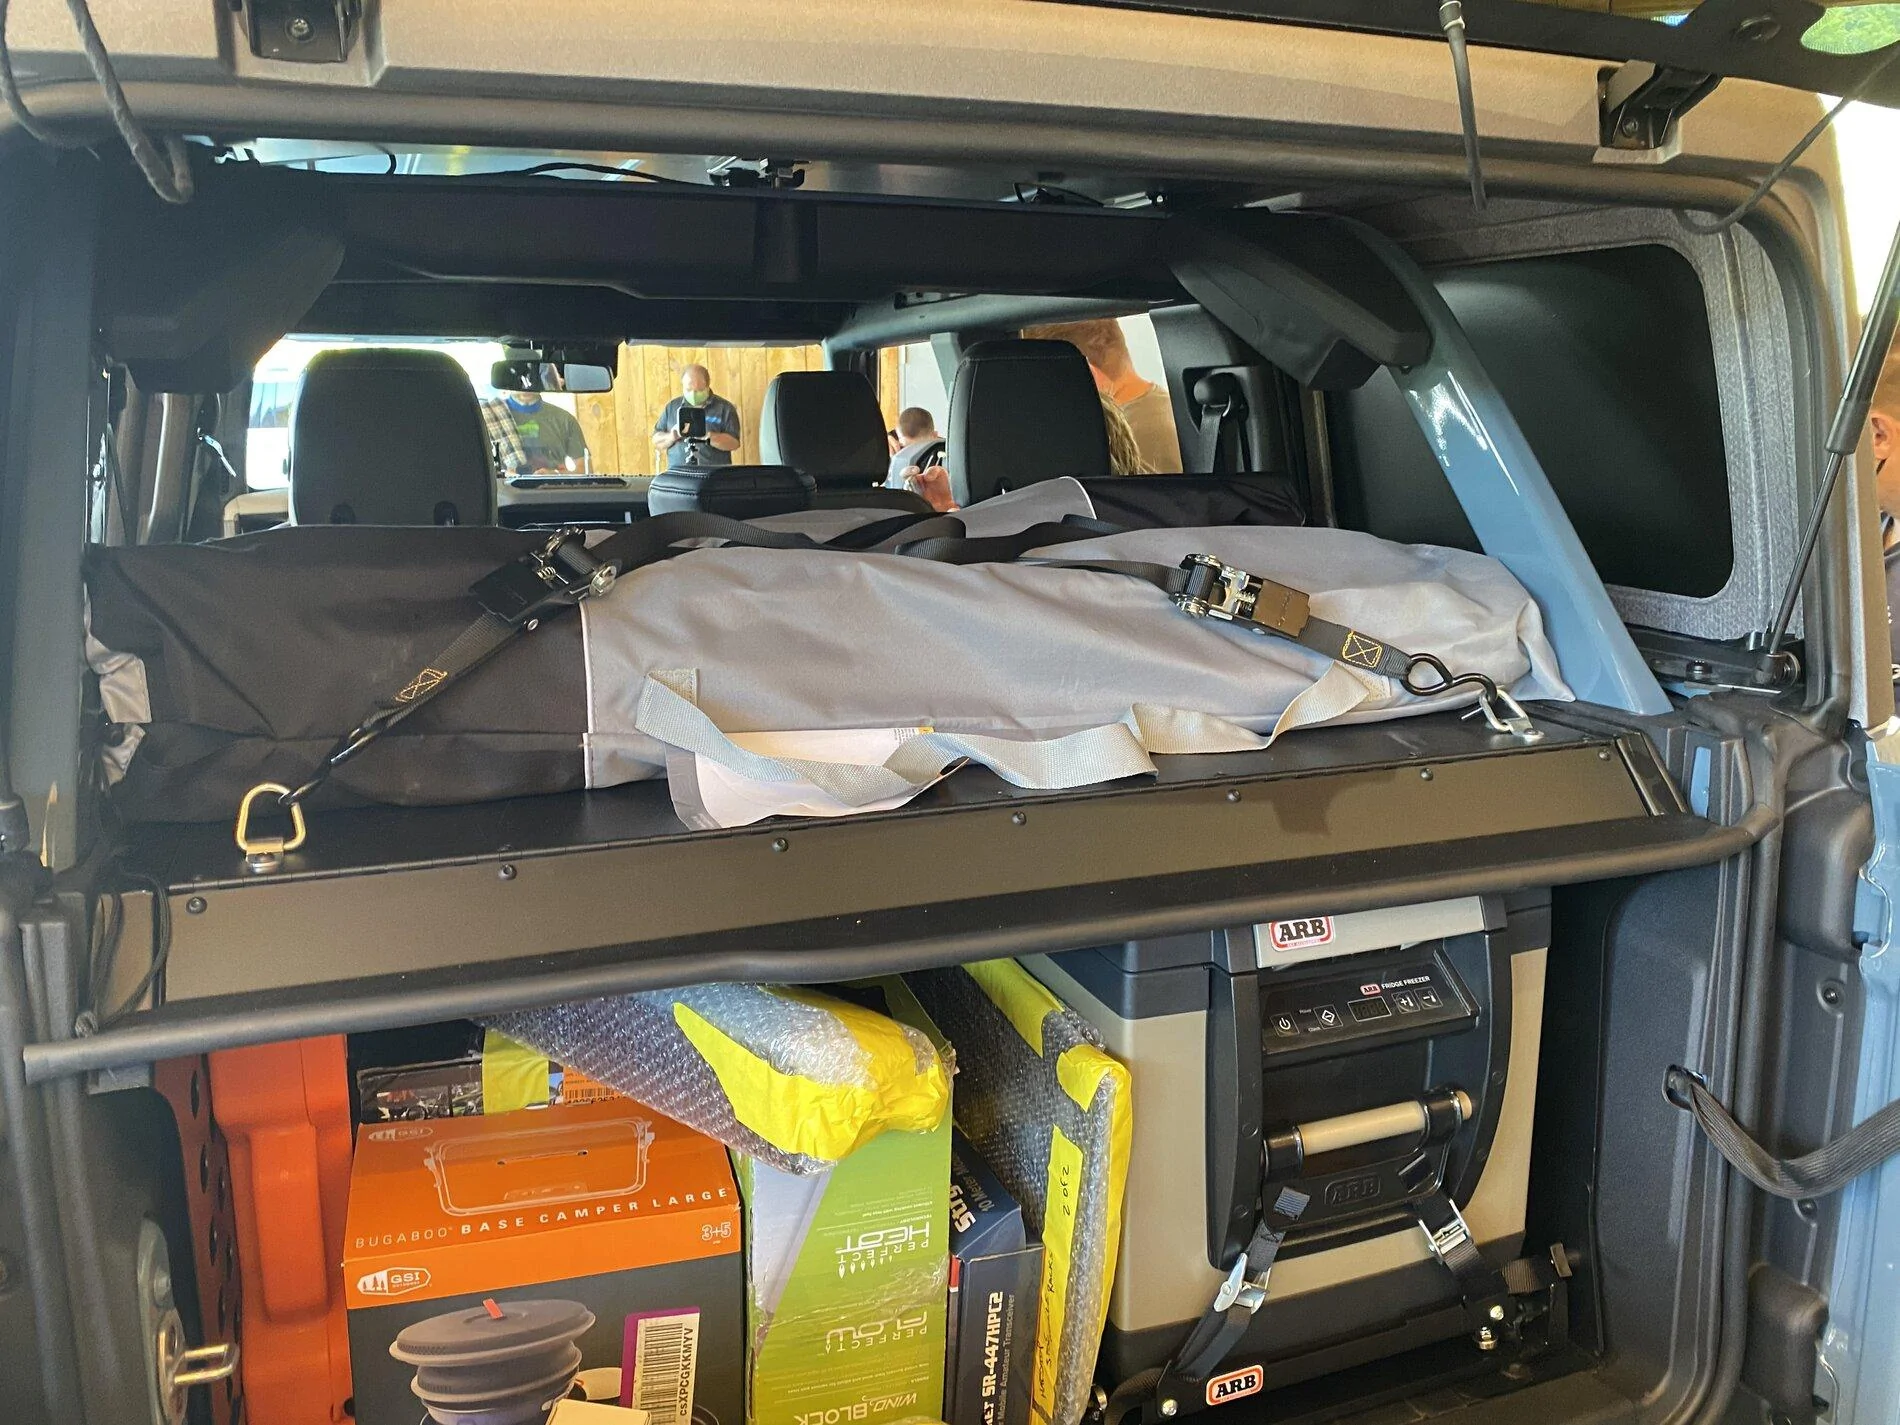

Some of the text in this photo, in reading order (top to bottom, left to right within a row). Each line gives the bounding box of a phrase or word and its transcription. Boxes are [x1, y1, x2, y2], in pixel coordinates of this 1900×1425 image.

[1280, 919, 1326, 942] ARB
[1363, 976, 1431, 993] ARB FRIDGE FREEZER
[1062, 1164, 1070, 1176] 2
[355, 1188, 729, 1249] BUGABOO BASE CAMPER LARGE
[1062, 1204, 1071, 1216] 2
[701, 1221, 731, 1241] 3+5
[838, 1239, 930, 1264] PERFECT
[390, 1271, 420, 1284] GSI
[1003, 1294, 1015, 1346] Transceiver
[837, 1325, 927, 1352] PERFECT
[982, 1291, 1003, 1397] SR-447HPC2
[1000, 1348, 1010, 1387] Amateur
[1216, 1375, 1256, 1398] ARB
[793, 1393, 917, 1425] WIND BLOCK
[997, 1388, 1007, 1420] Mobile
